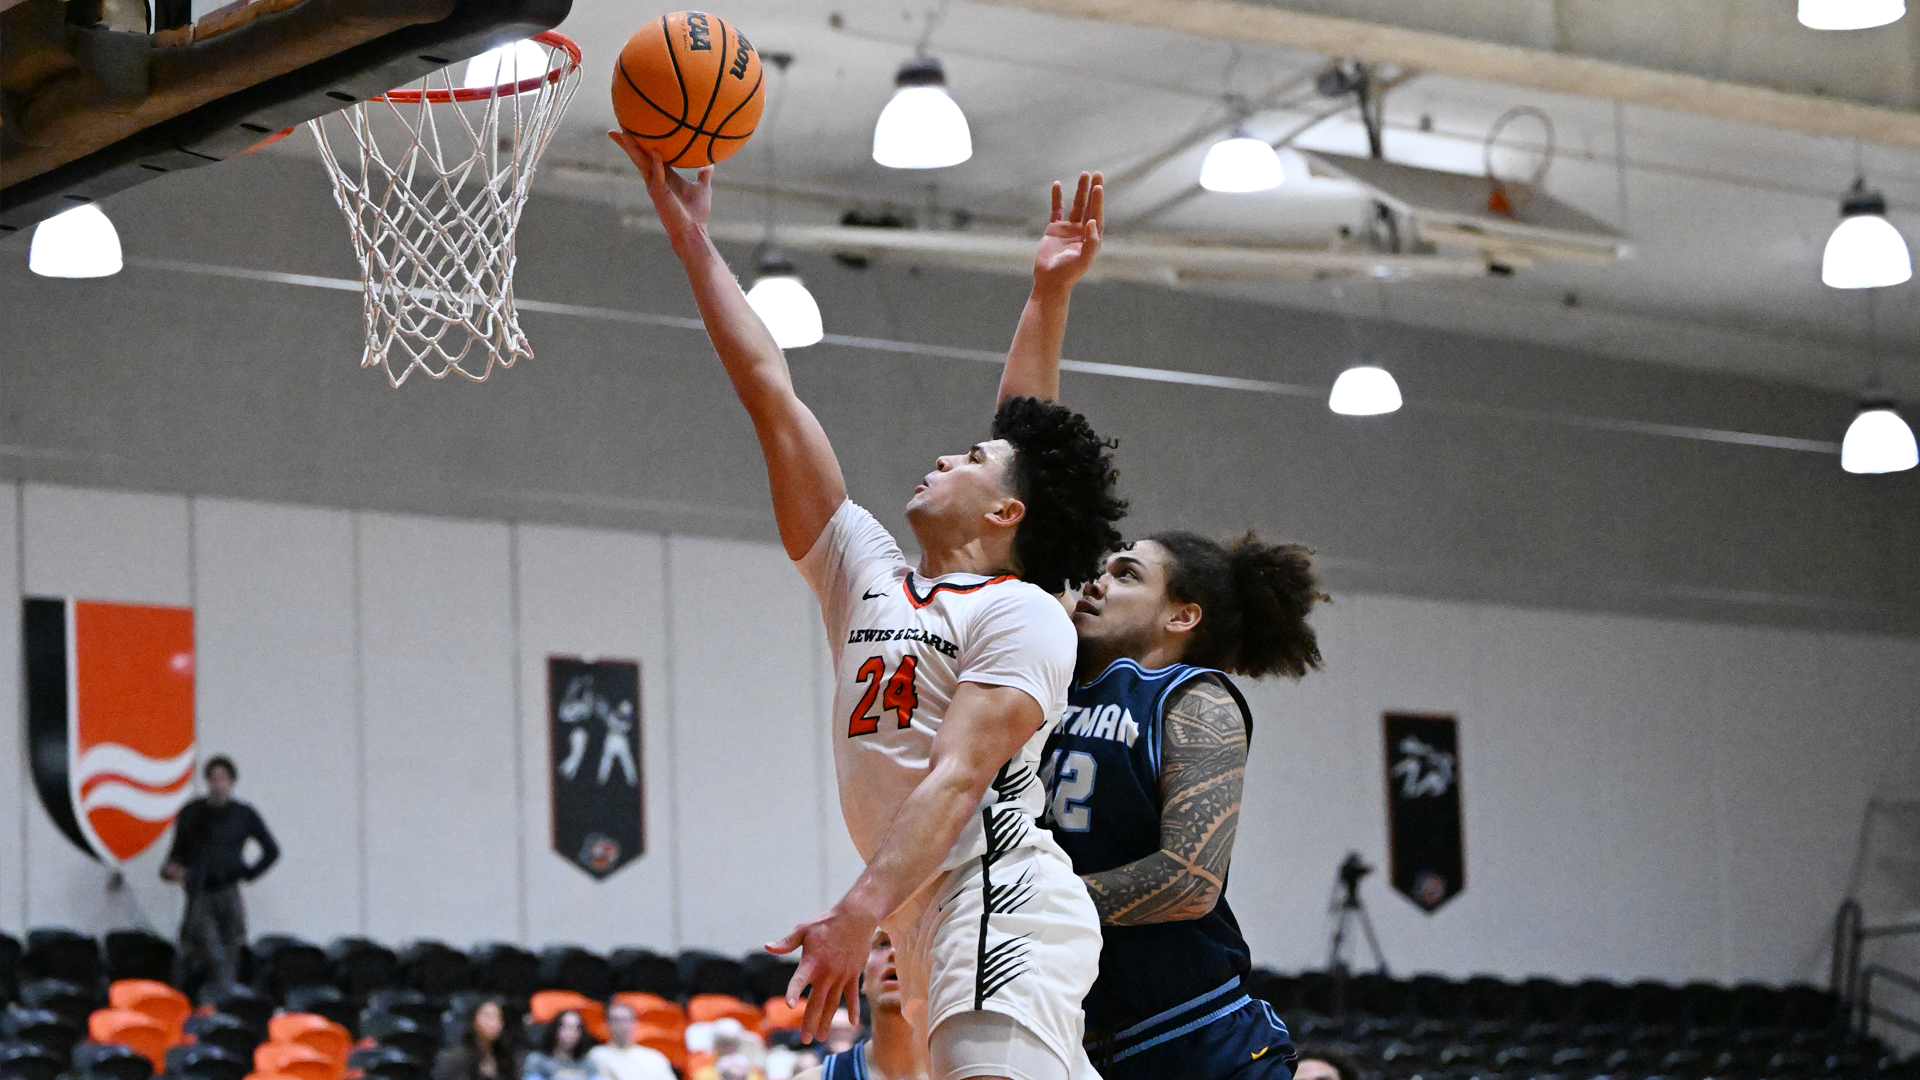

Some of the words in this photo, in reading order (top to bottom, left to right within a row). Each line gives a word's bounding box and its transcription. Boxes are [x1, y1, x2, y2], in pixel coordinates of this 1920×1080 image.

[848, 629, 895, 644] LEWIS
[893, 629, 905, 641] &
[904, 628, 959, 659] CLARK
[848, 654, 918, 738] 24
[1054, 703, 1139, 749] TMAN
